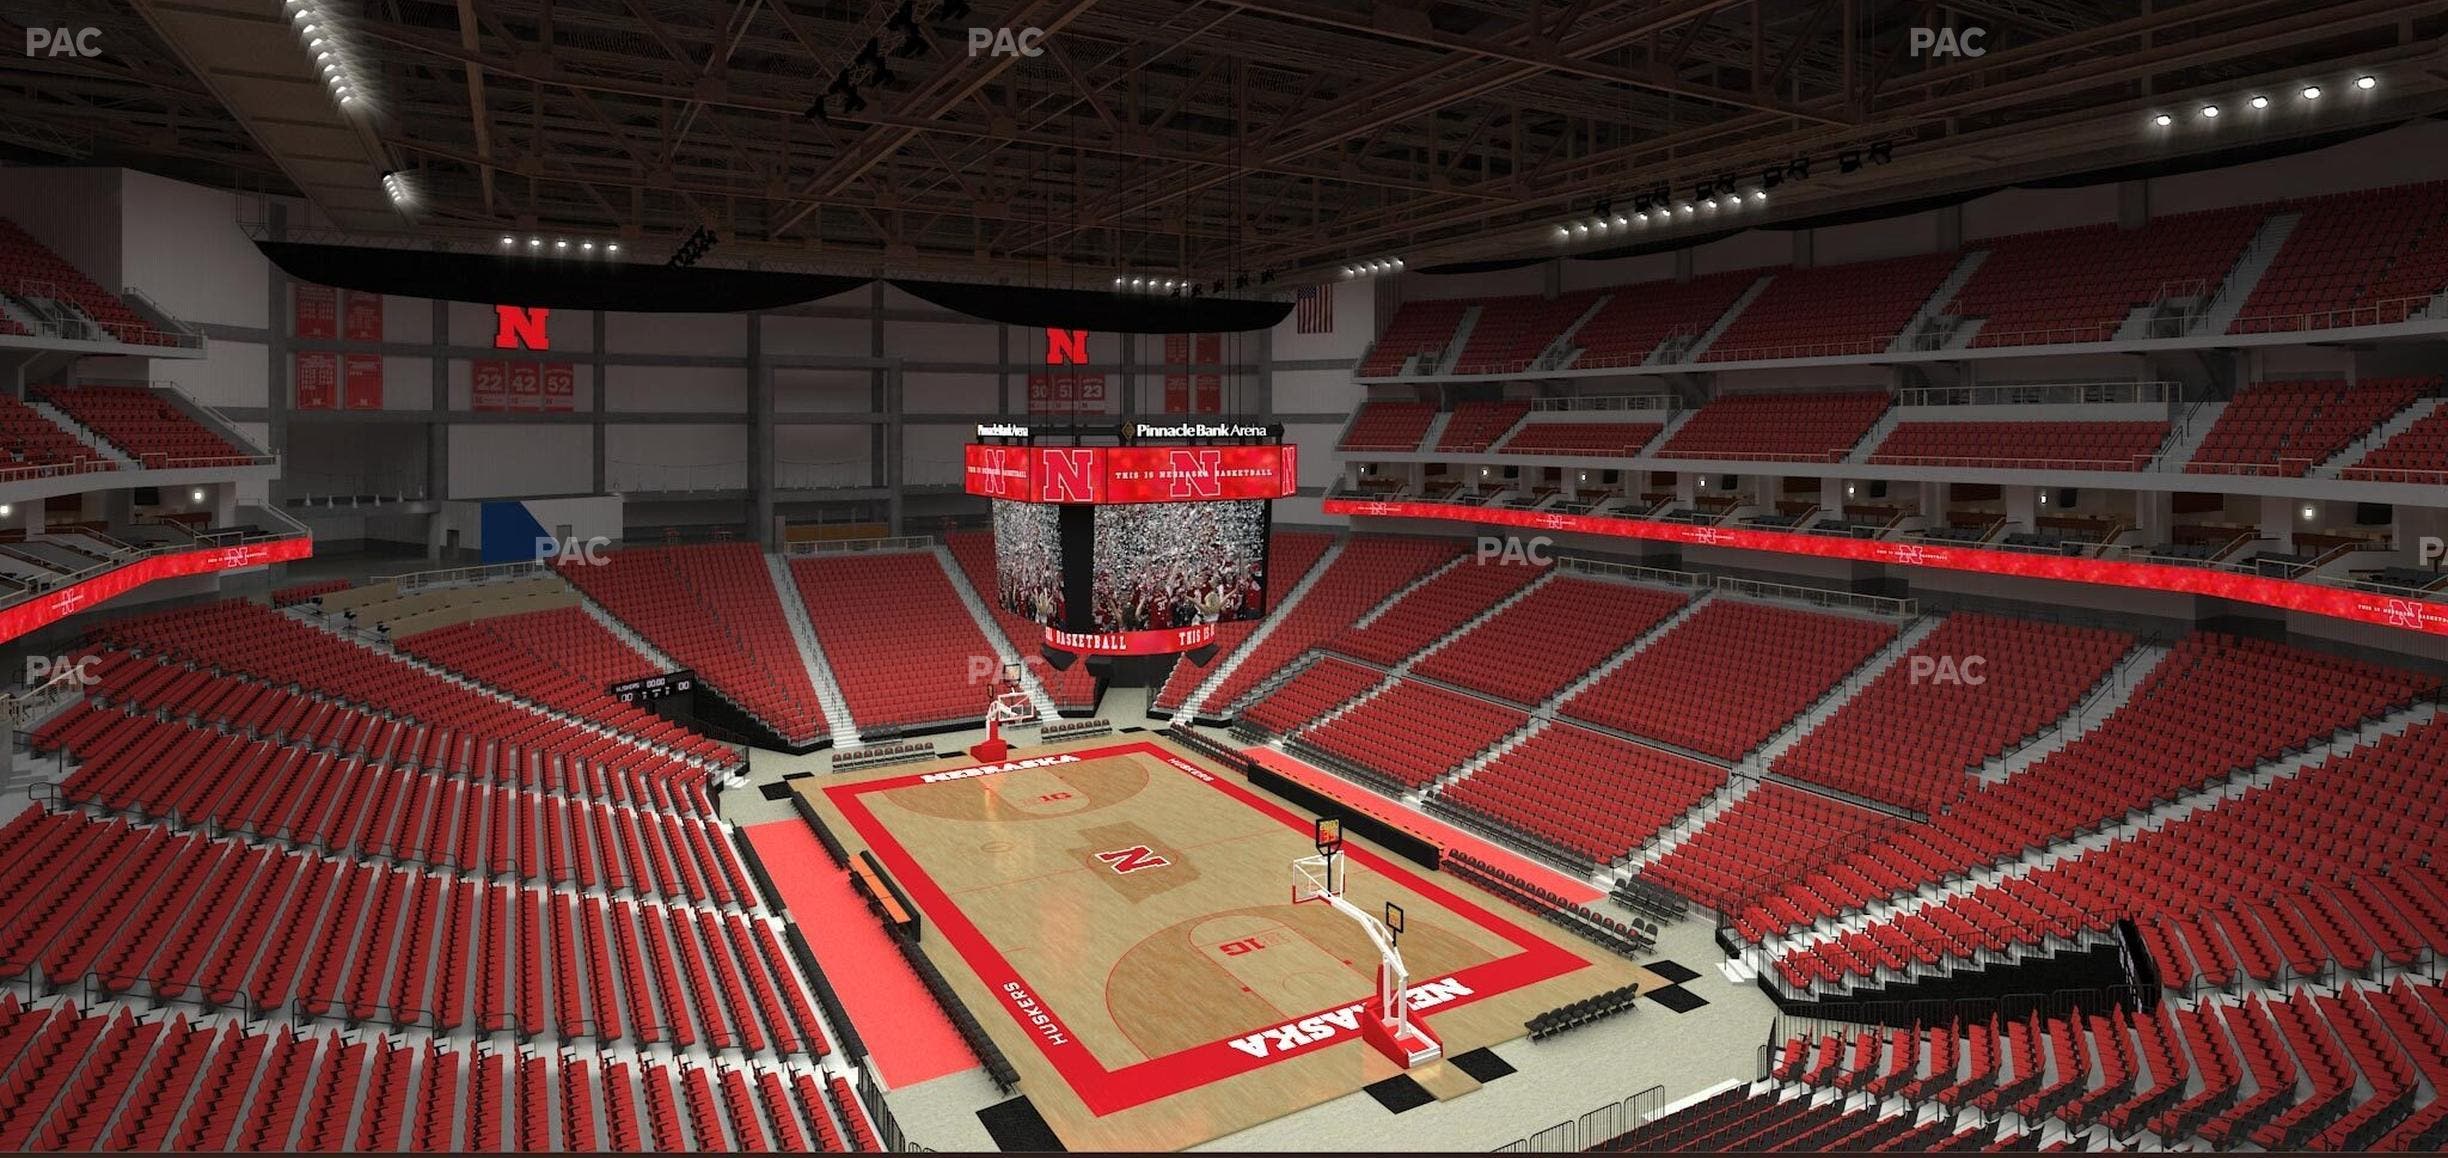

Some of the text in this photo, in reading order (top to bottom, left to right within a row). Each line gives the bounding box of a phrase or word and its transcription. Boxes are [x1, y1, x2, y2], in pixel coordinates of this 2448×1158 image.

[494, 304, 550, 350] N
[1046, 327, 1089, 364] N
[478, 374, 502, 391] 22
[512, 375, 537, 392] 42
[1083, 384, 1103, 398] 23
[1136, 424, 1266, 437] Pinnacle Bank Arena
[1043, 449, 1093, 502] N
[1170, 450, 1220, 497] N
[1056, 631, 1127, 650] BASKETBALL
[1178, 629, 1201, 646] THIS
[920, 753, 1081, 783] NEBRASKA
[1094, 844, 1171, 875] N
[1003, 981, 1068, 1046] HUSKERS
